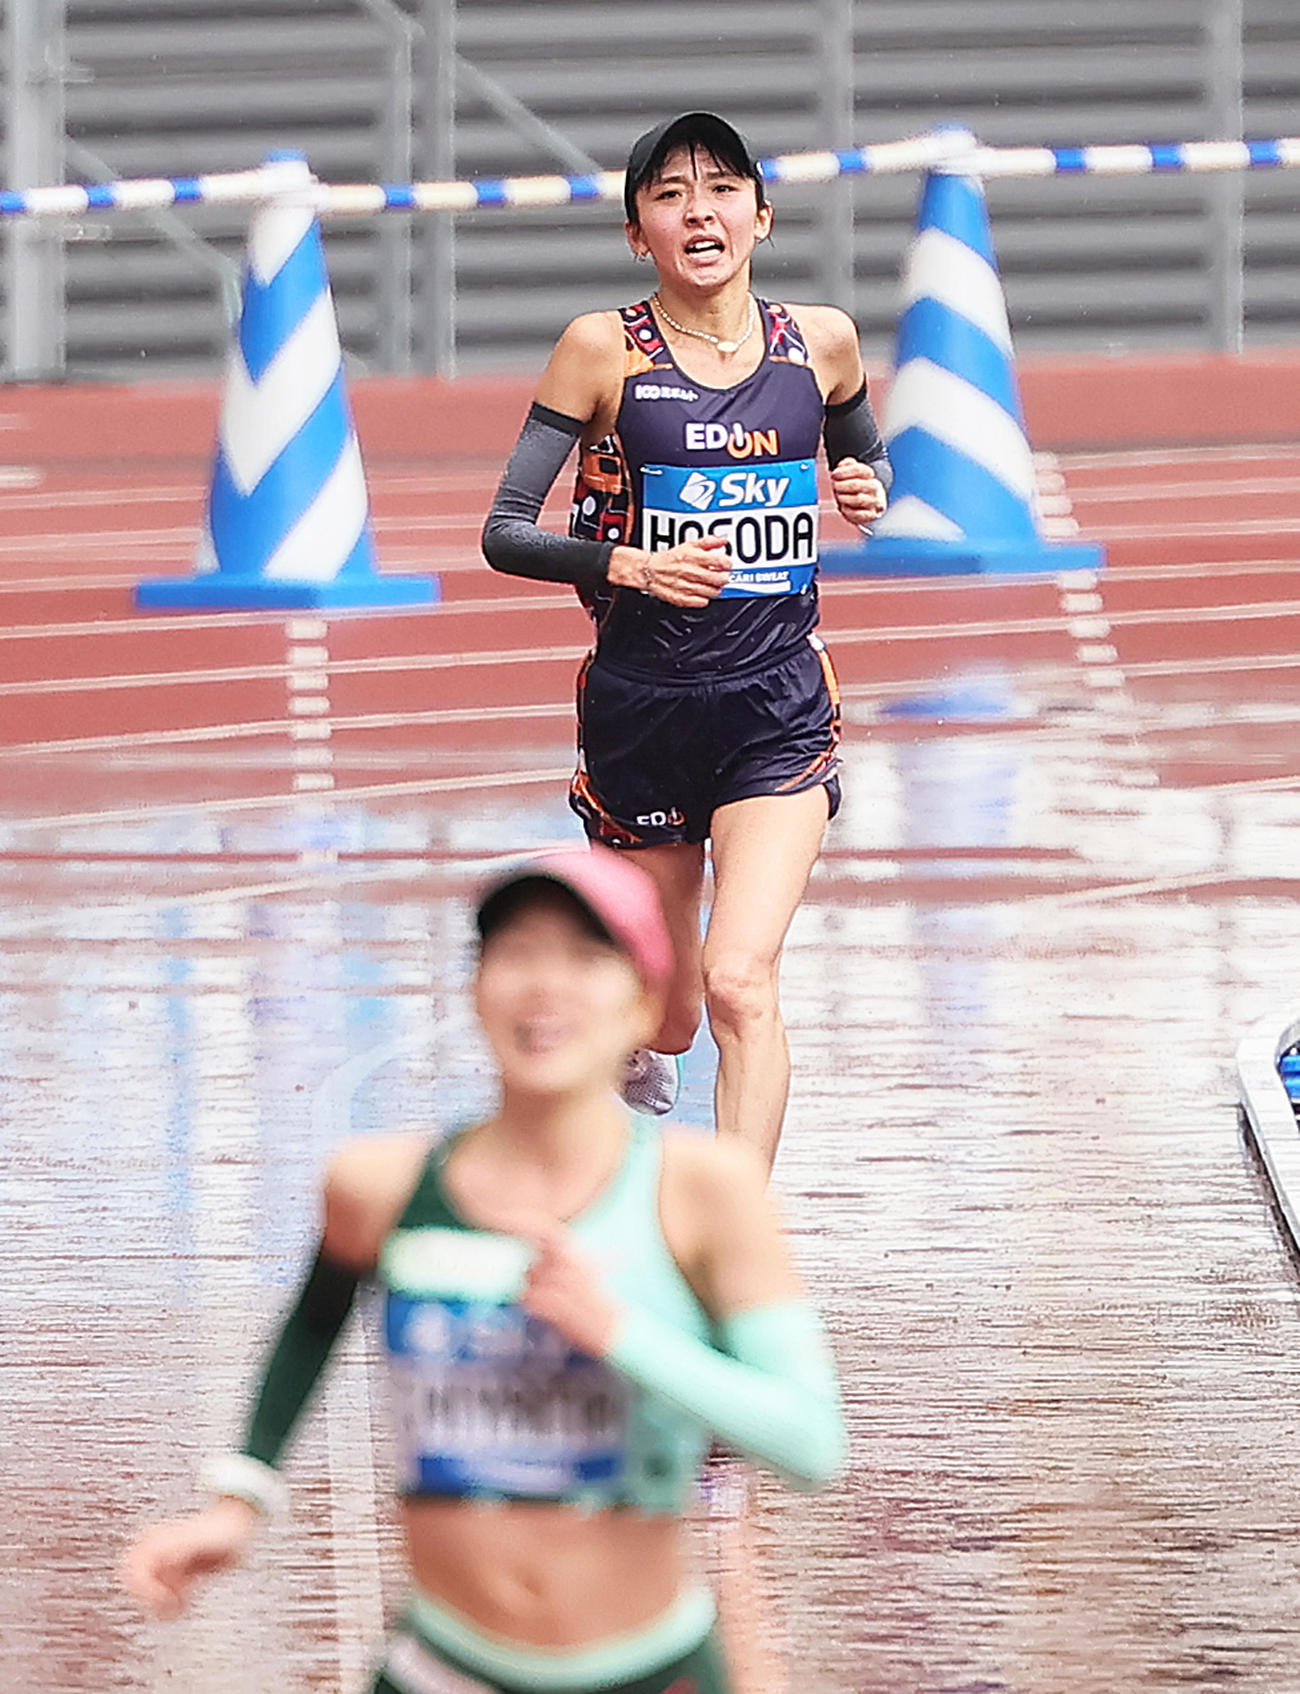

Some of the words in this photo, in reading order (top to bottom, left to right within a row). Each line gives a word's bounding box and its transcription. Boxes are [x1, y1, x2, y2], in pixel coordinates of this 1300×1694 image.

[685, 421, 779, 459] EDION
[718, 472, 790, 507] Sky
[636, 806, 685, 826] EDIO
